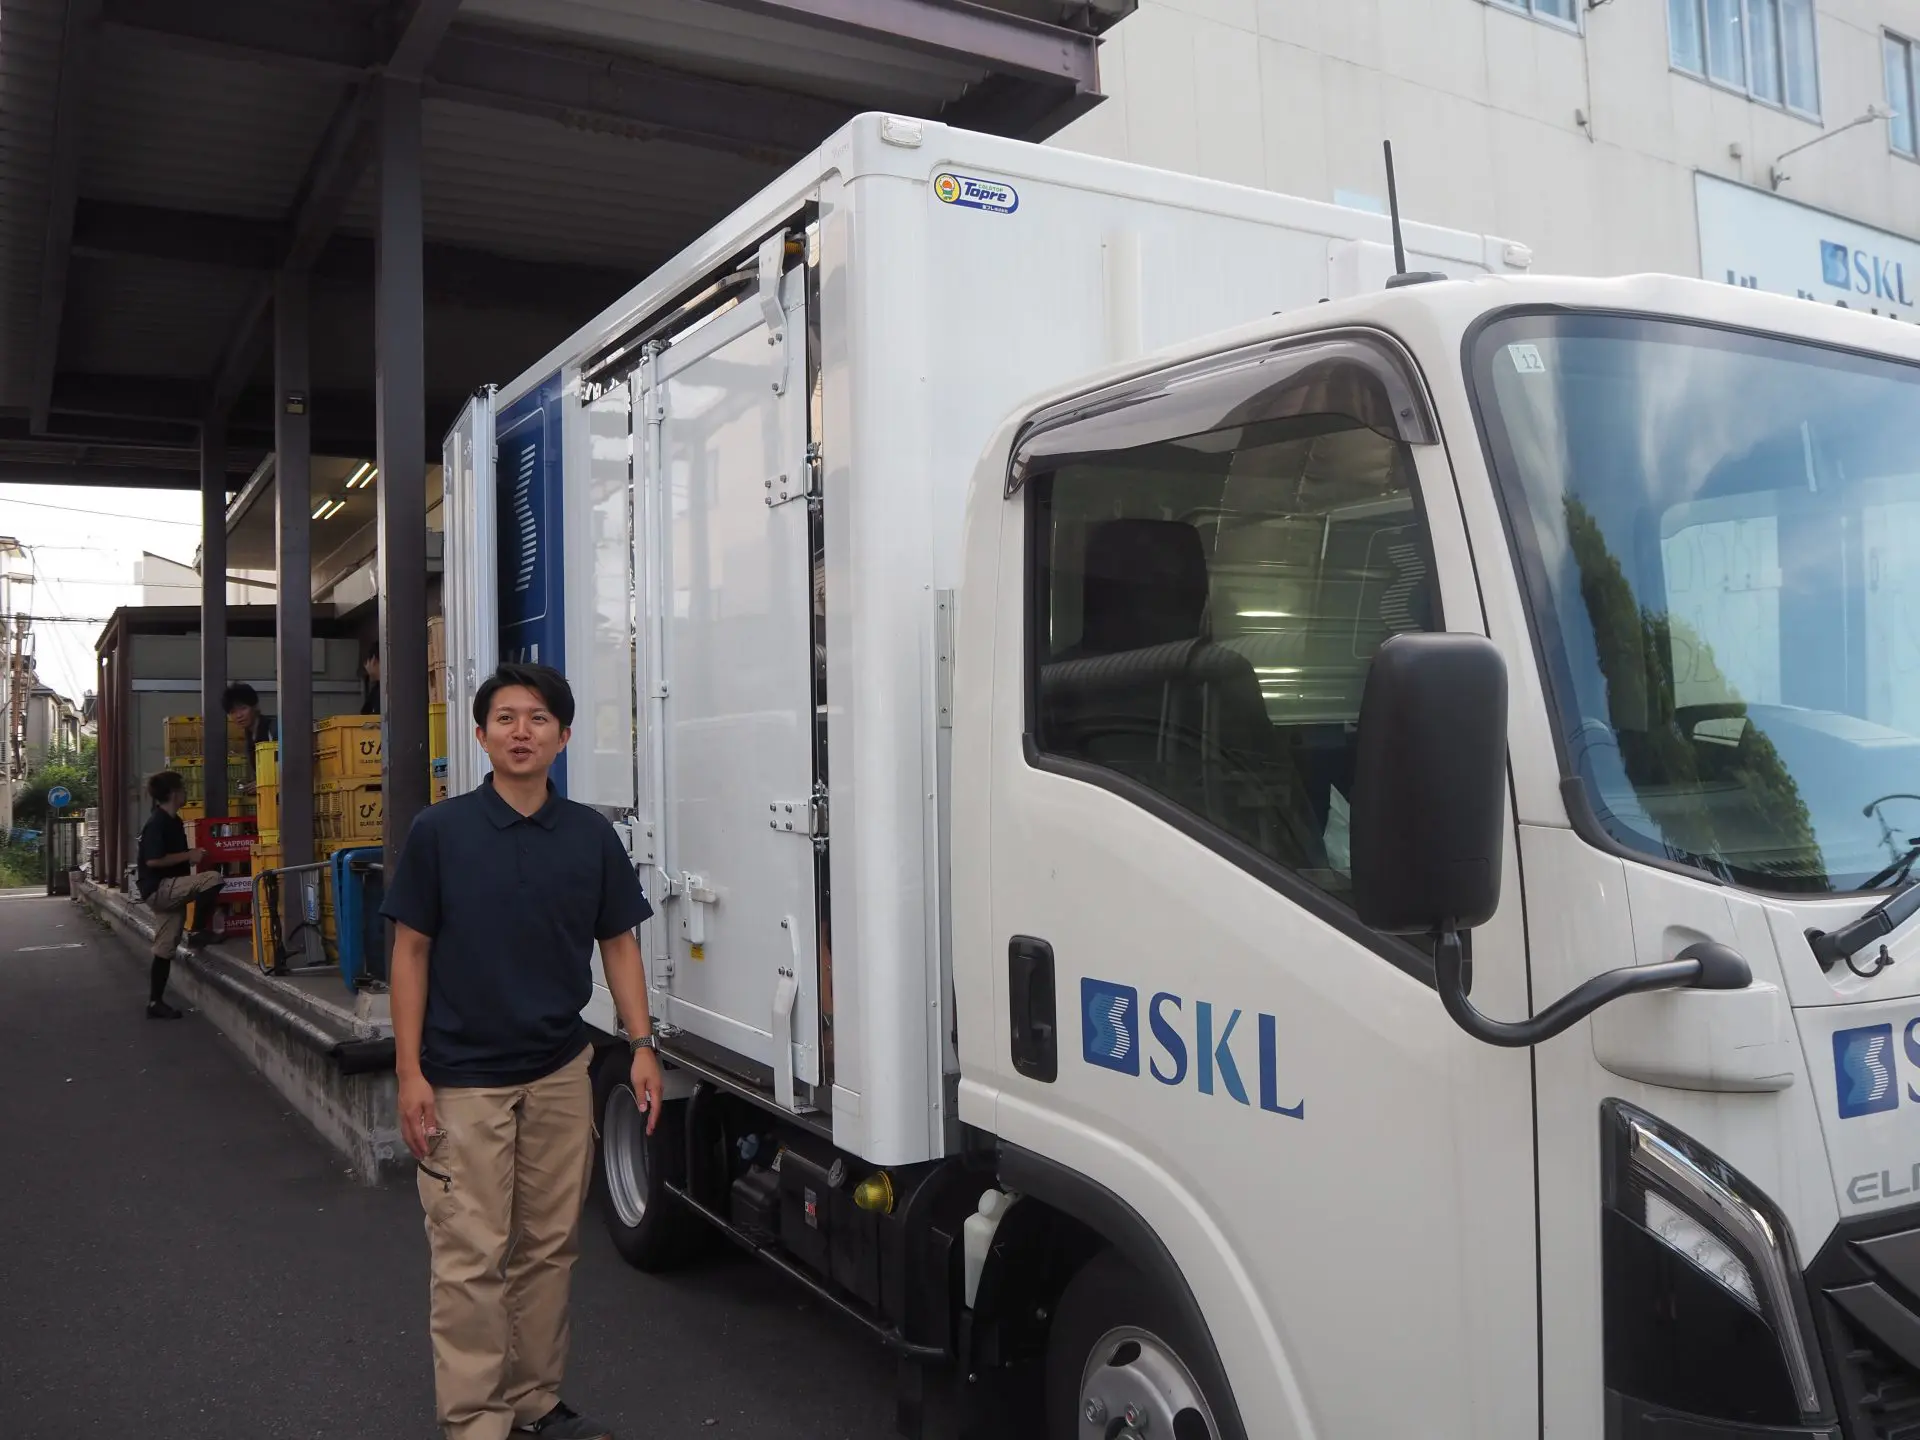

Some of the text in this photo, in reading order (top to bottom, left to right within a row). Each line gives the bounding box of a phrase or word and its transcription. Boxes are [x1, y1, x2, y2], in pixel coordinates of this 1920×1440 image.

[964, 181, 1007, 202] Topre
[1853, 249, 1914, 307] SKL
[1522, 353, 1541, 369] 12
[359, 802, 383, 818] び
[222, 839, 255, 848] SAPPORO
[225, 880, 252, 888] SAPPOR
[1148, 991, 1304, 1120] SKL
